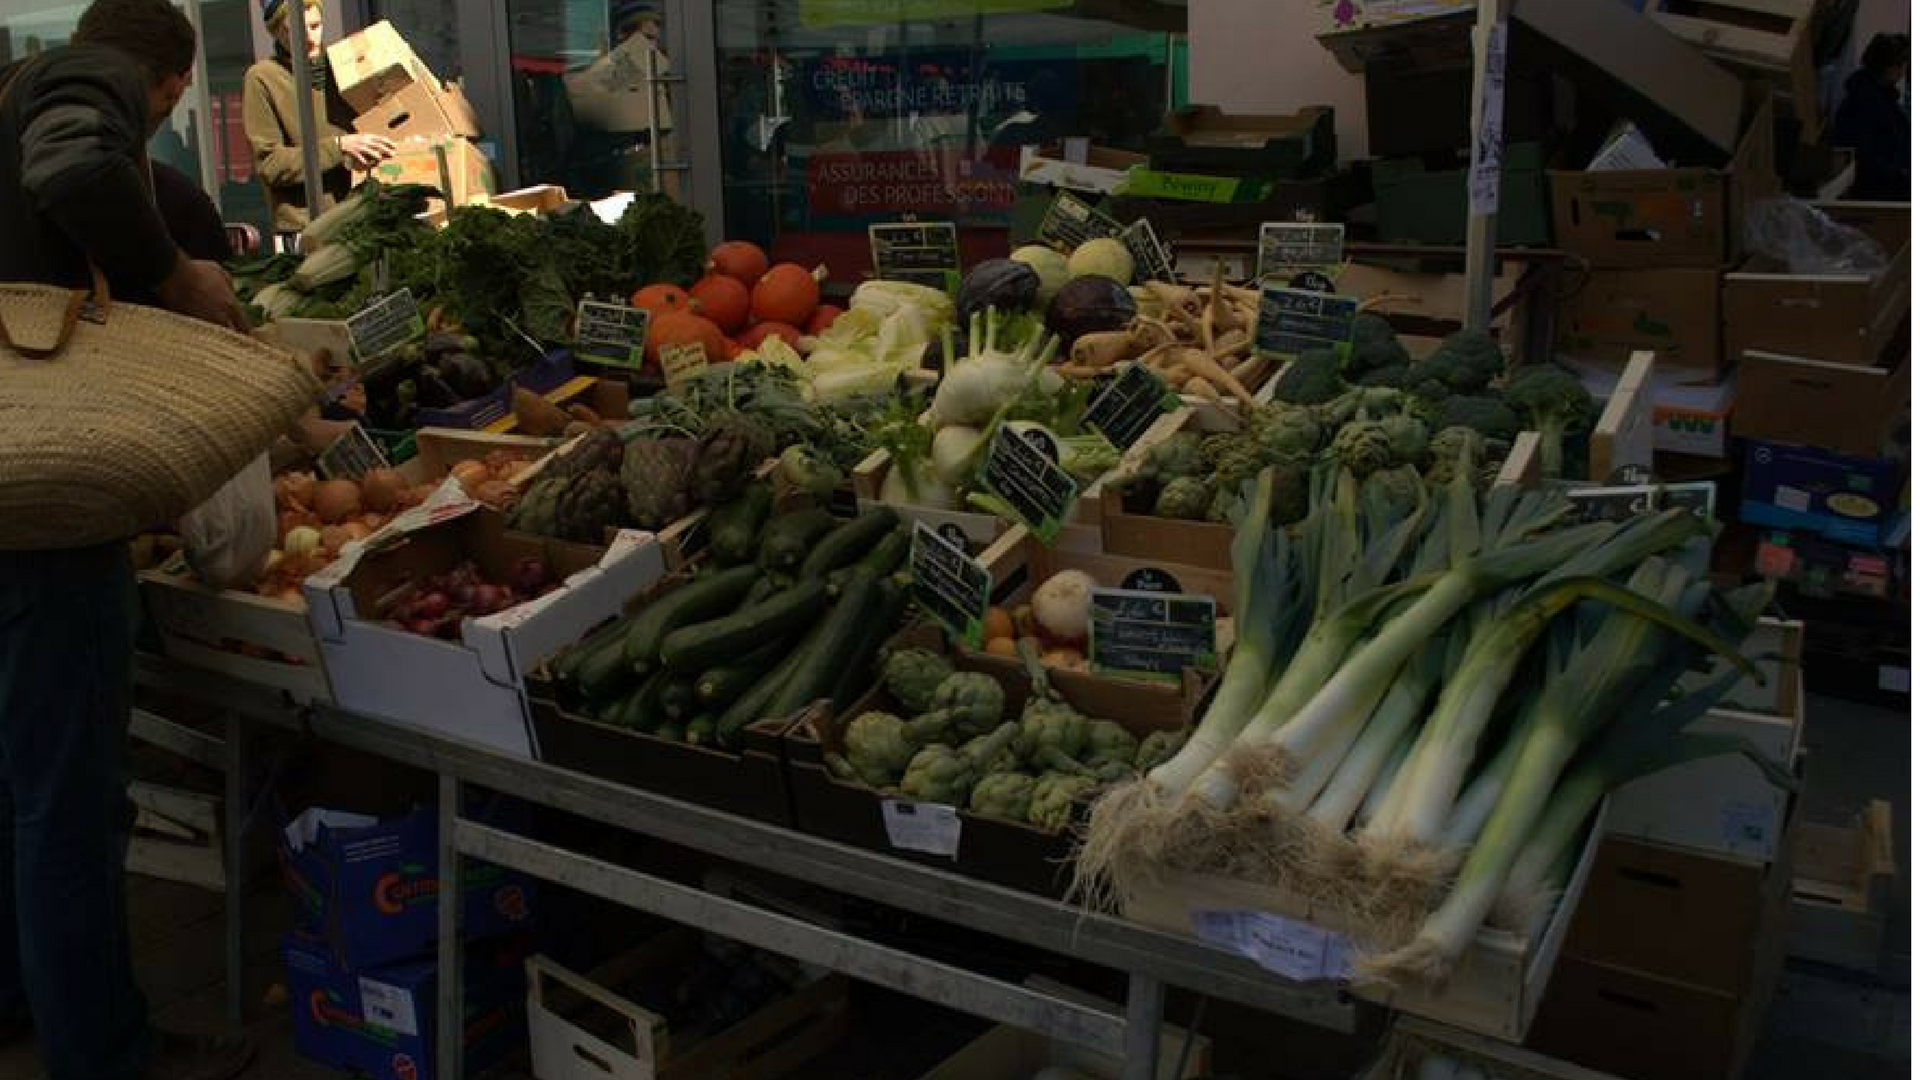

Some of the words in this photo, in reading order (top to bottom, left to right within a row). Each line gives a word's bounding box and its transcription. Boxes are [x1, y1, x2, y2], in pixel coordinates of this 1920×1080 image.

[932, 82, 1026, 104] RETRAITE
[819, 162, 939, 185] ASSURANCES
[841, 185, 881, 205] DES
